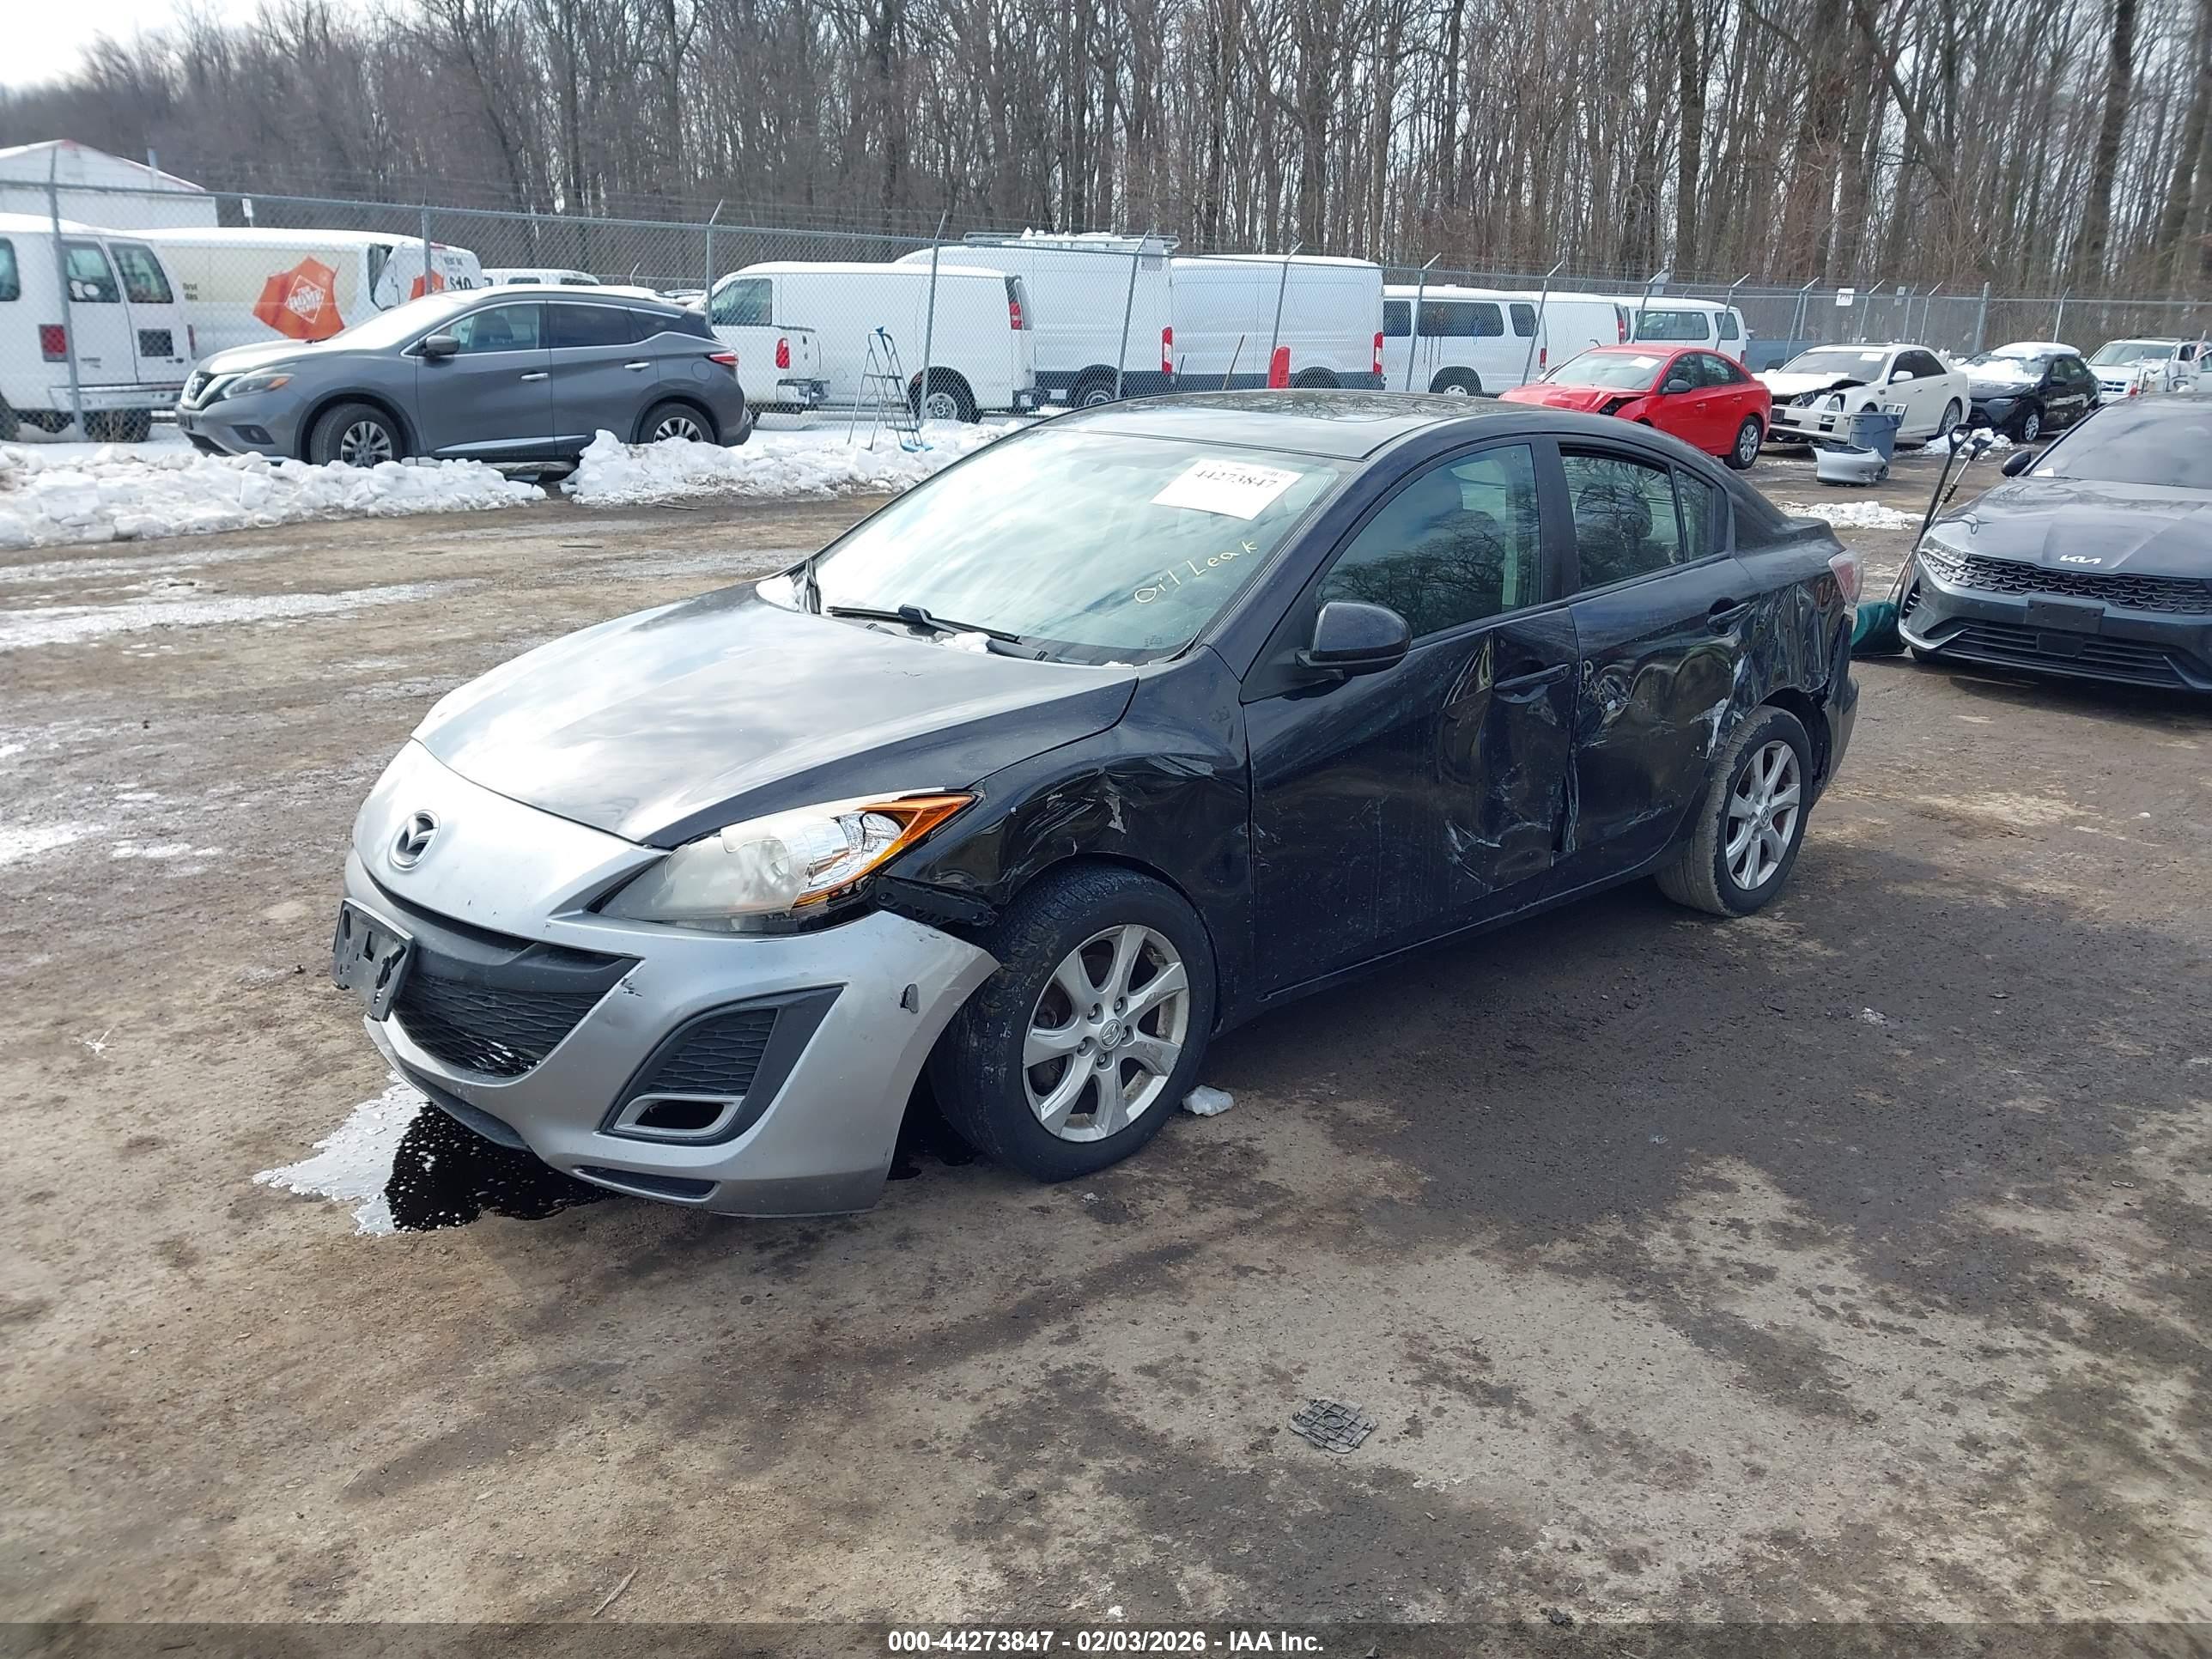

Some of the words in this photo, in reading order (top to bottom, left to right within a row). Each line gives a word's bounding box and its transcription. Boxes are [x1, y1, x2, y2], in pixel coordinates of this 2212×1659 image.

[1195, 470, 1278, 488] 44273847
[1134, 570, 1181, 603] Oil
[1187, 541, 1258, 576] Leak
